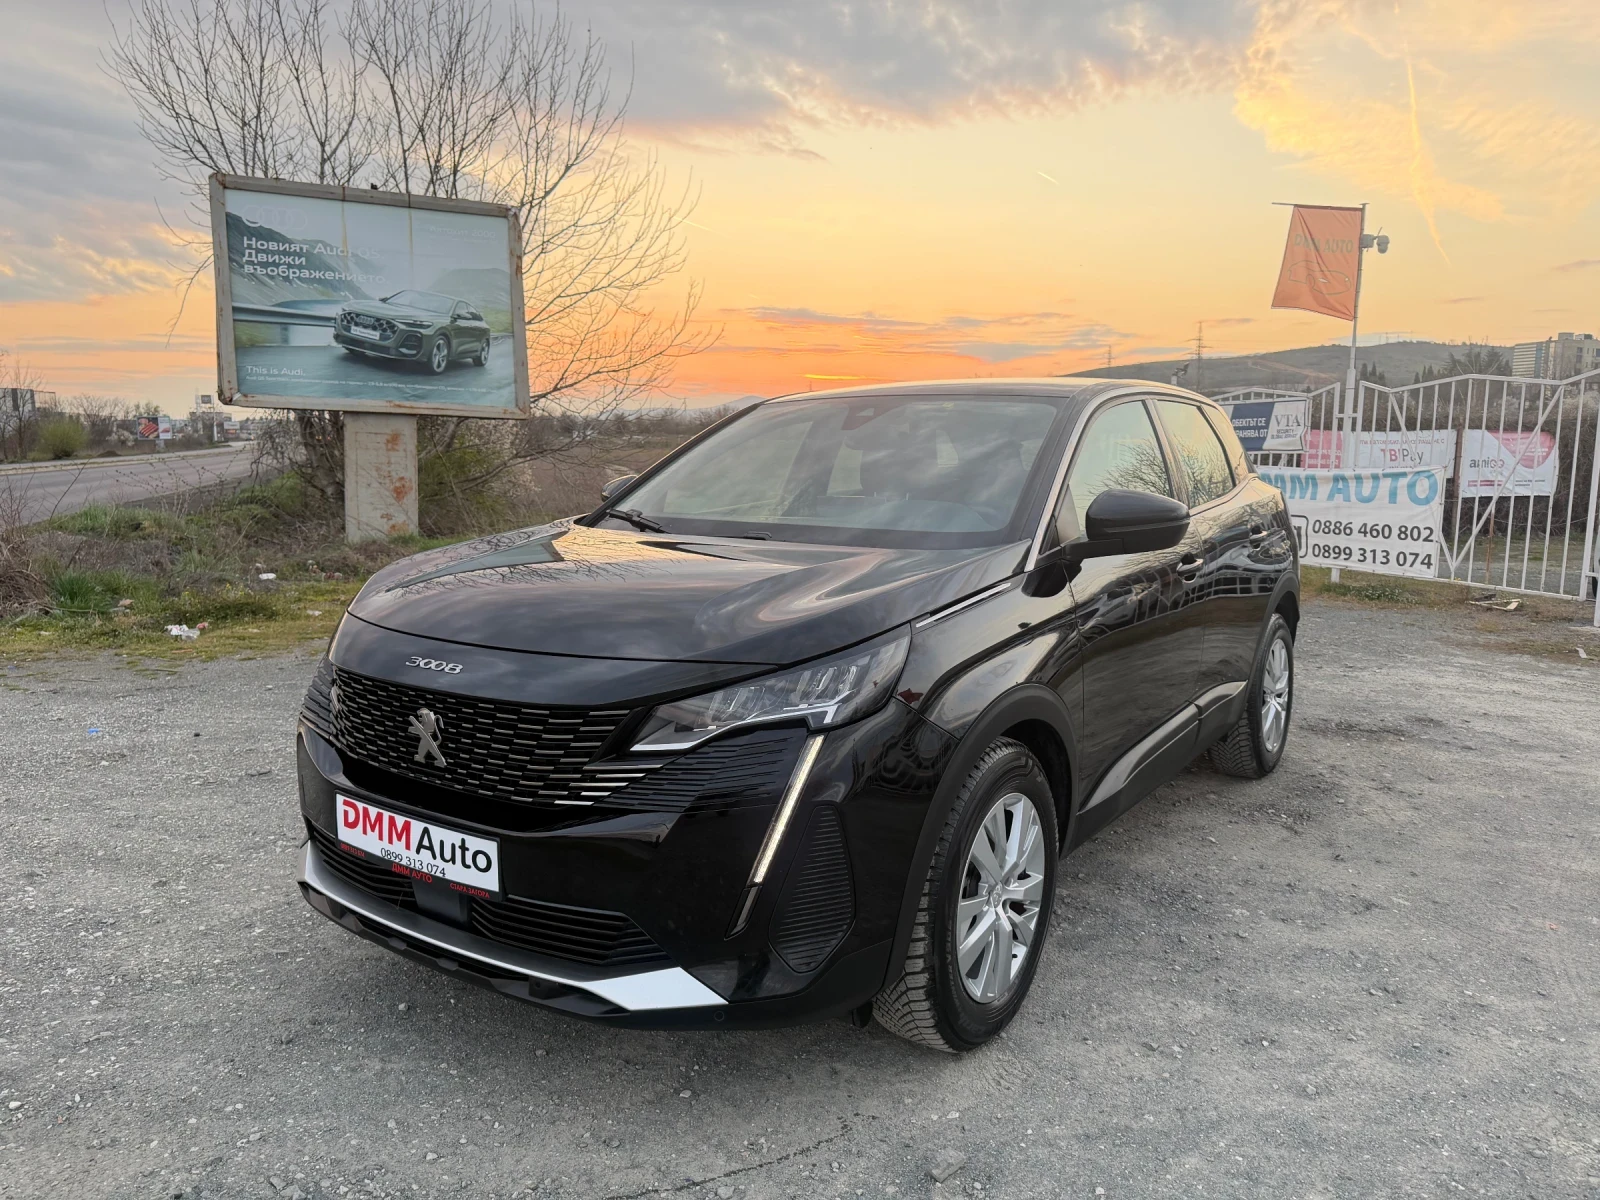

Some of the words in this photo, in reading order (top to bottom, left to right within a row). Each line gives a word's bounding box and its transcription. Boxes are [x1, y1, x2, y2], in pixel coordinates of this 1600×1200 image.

[243, 236, 309, 253] Новият
[313, 243, 353, 257] Audi
[1323, 238, 1354, 254] AUTO
[242, 249, 307, 265] Движи
[245, 365, 268, 375] This
[270, 366, 279, 375] is
[281, 367, 306, 377] Audi.
[1257, 417, 1266, 426] СЕ
[1274, 414, 1302, 428] VTA
[1236, 429, 1259, 438] РАНЯВА
[1259, 429, 1268, 438] ОТ
[1260, 472, 1319, 500] MM
[1327, 470, 1439, 506] AUTO
[1312, 519, 1354, 536] 0886
[1358, 522, 1393, 540] 460
[1397, 524, 1435, 543] 802
[1312, 543, 1353, 561] 0899
[1357, 547, 1391, 565] 313
[1395, 551, 1433, 570] 074
[405, 656, 463, 674] 3008
[342, 798, 412, 852] DMM
[415, 826, 493, 873] Auto
[380, 847, 403, 863] 0899
[405, 856, 424, 871] 313
[426, 862, 446, 878] 074
[411, 869, 433, 883] АУТО
[449, 882, 468, 892] СТАРА
